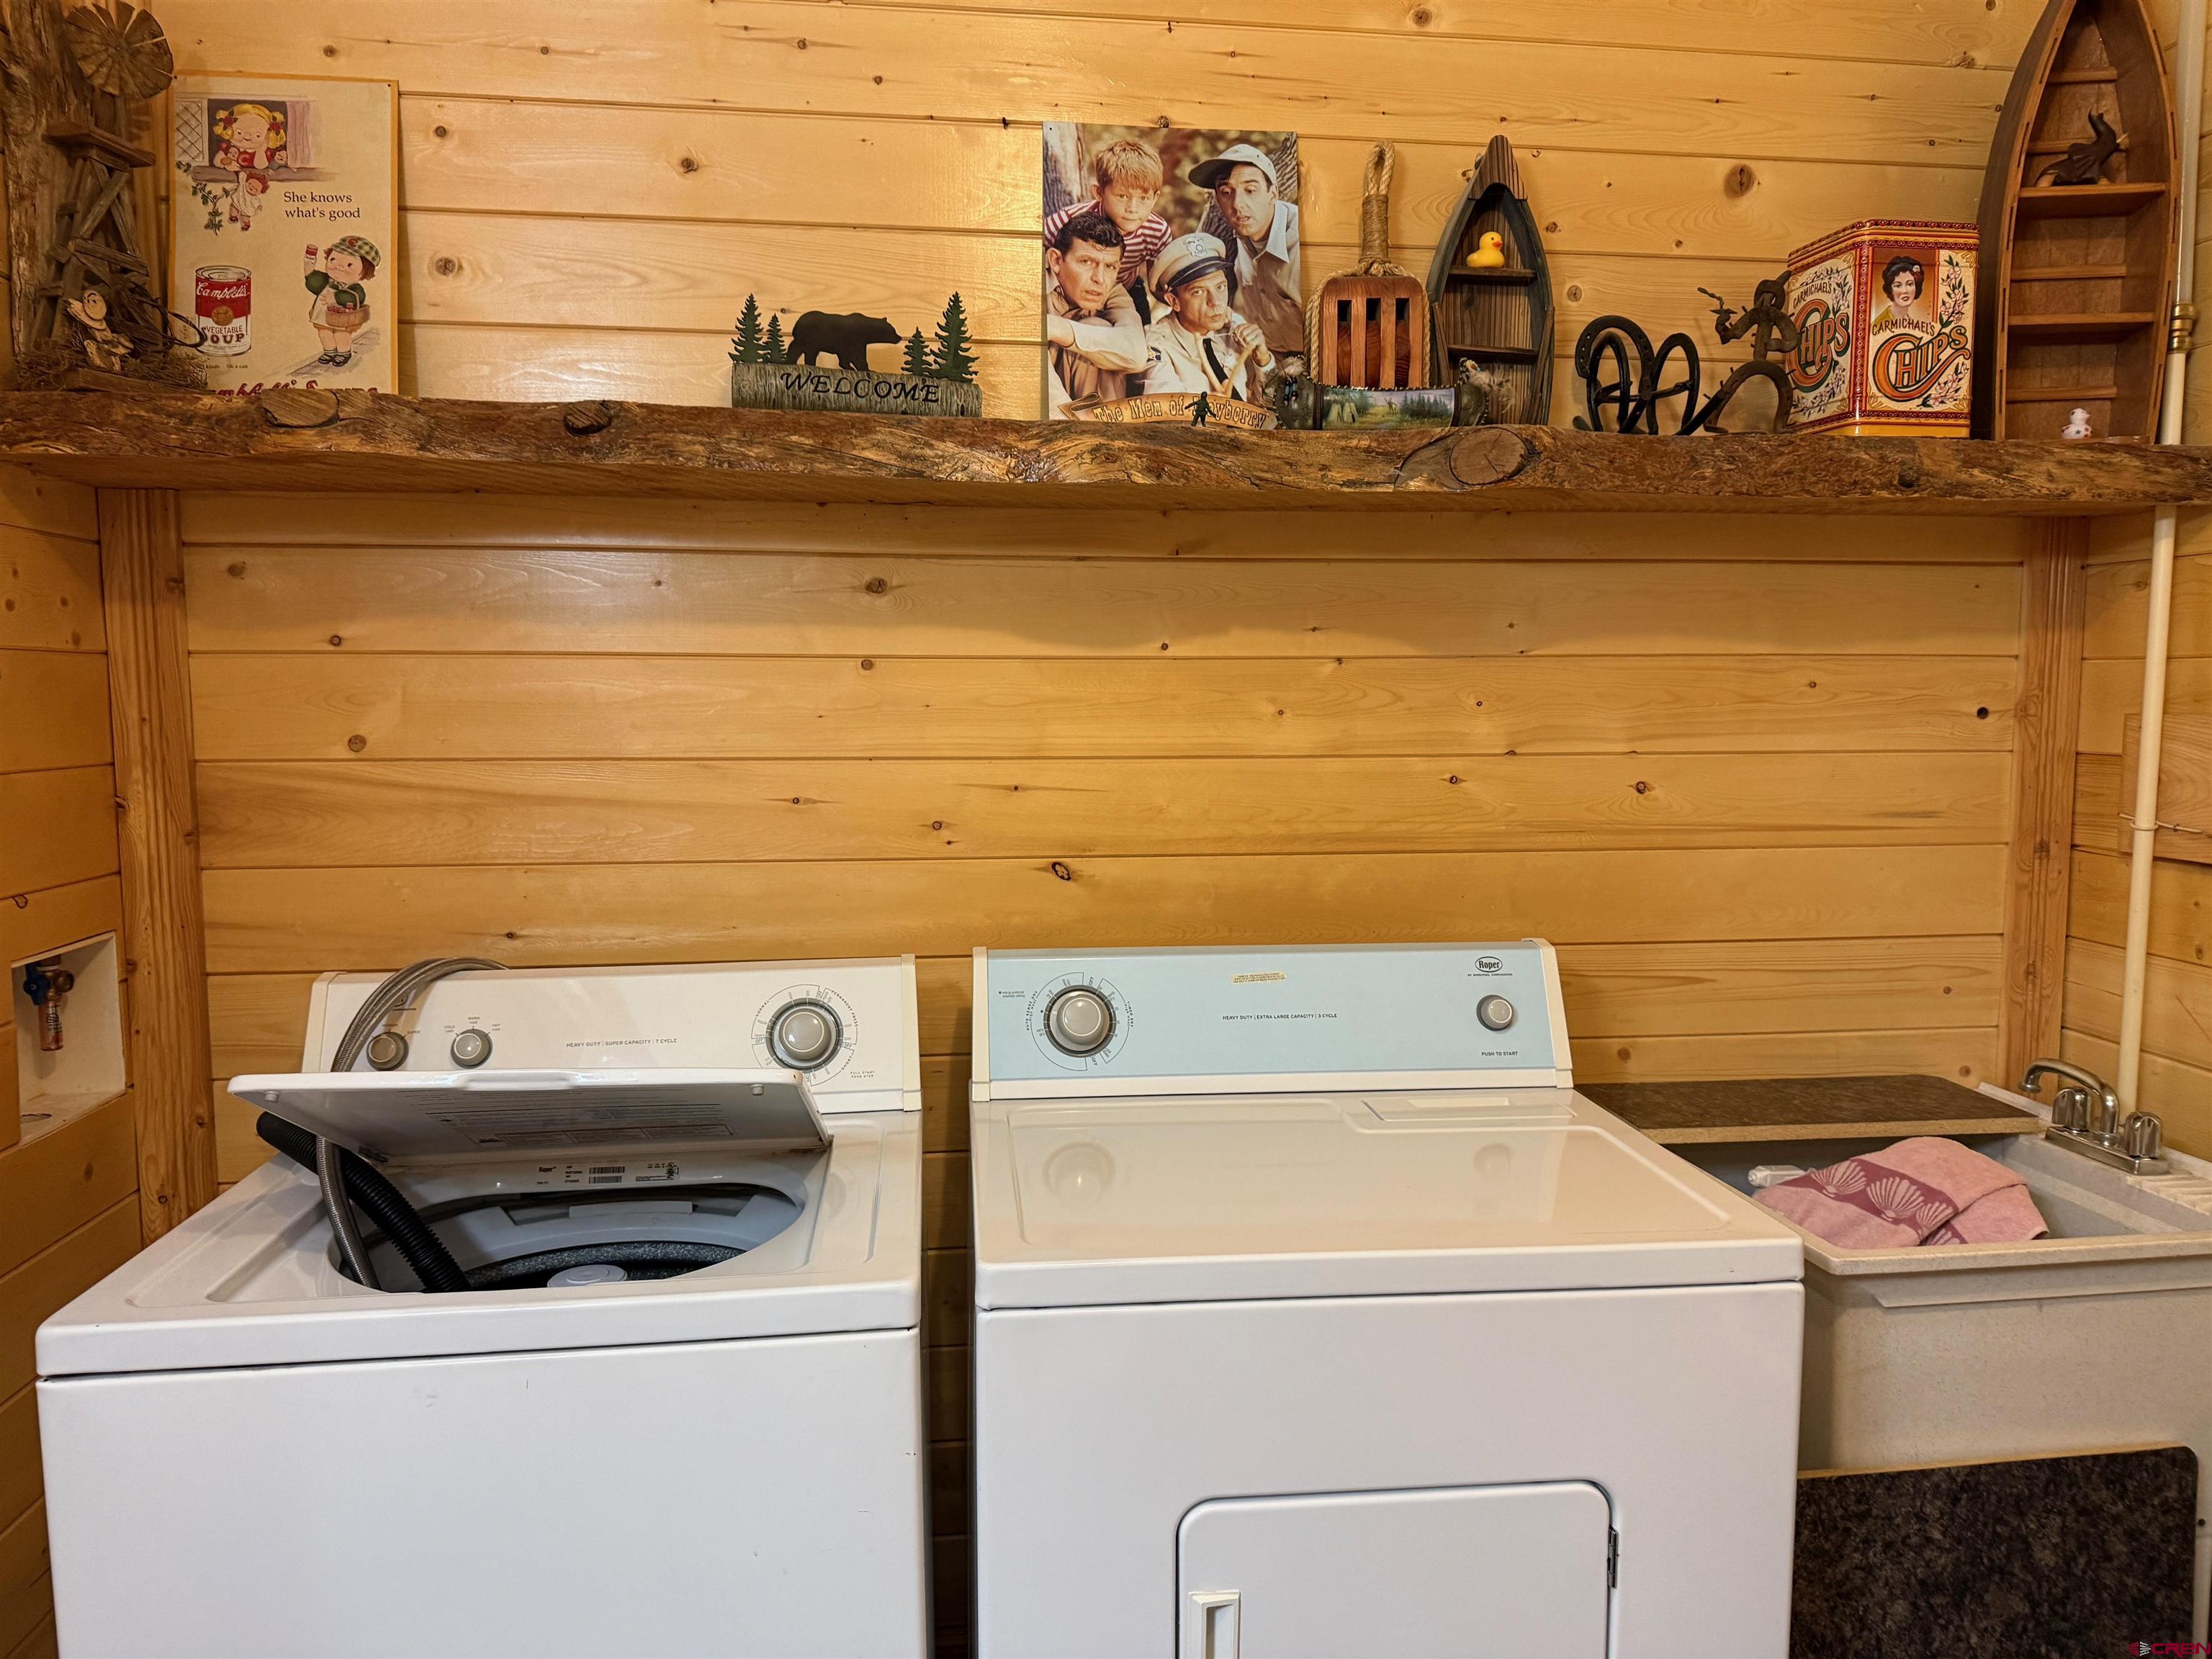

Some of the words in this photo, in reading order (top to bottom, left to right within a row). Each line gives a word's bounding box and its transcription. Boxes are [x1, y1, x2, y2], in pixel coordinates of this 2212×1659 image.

[284, 192, 307, 202] She
[310, 192, 352, 202] knows
[285, 207, 325, 218] what's
[328, 207, 361, 222] good
[197, 282, 248, 300] Campbell's
[1793, 282, 1832, 308] CARMICHAEL'S
[206, 325, 243, 335] VEGETABLE
[1872, 318, 1935, 336] CARMICHAEL'S
[1786, 299, 1851, 392] CHIPS
[1872, 325, 1972, 403] CHIPS
[781, 372, 940, 403] WELCOME
[1094, 405, 1123, 423] The
[1128, 398, 1162, 418] Men
[1169, 395, 1184, 416] of
[1478, 961, 1500, 970] Roper
